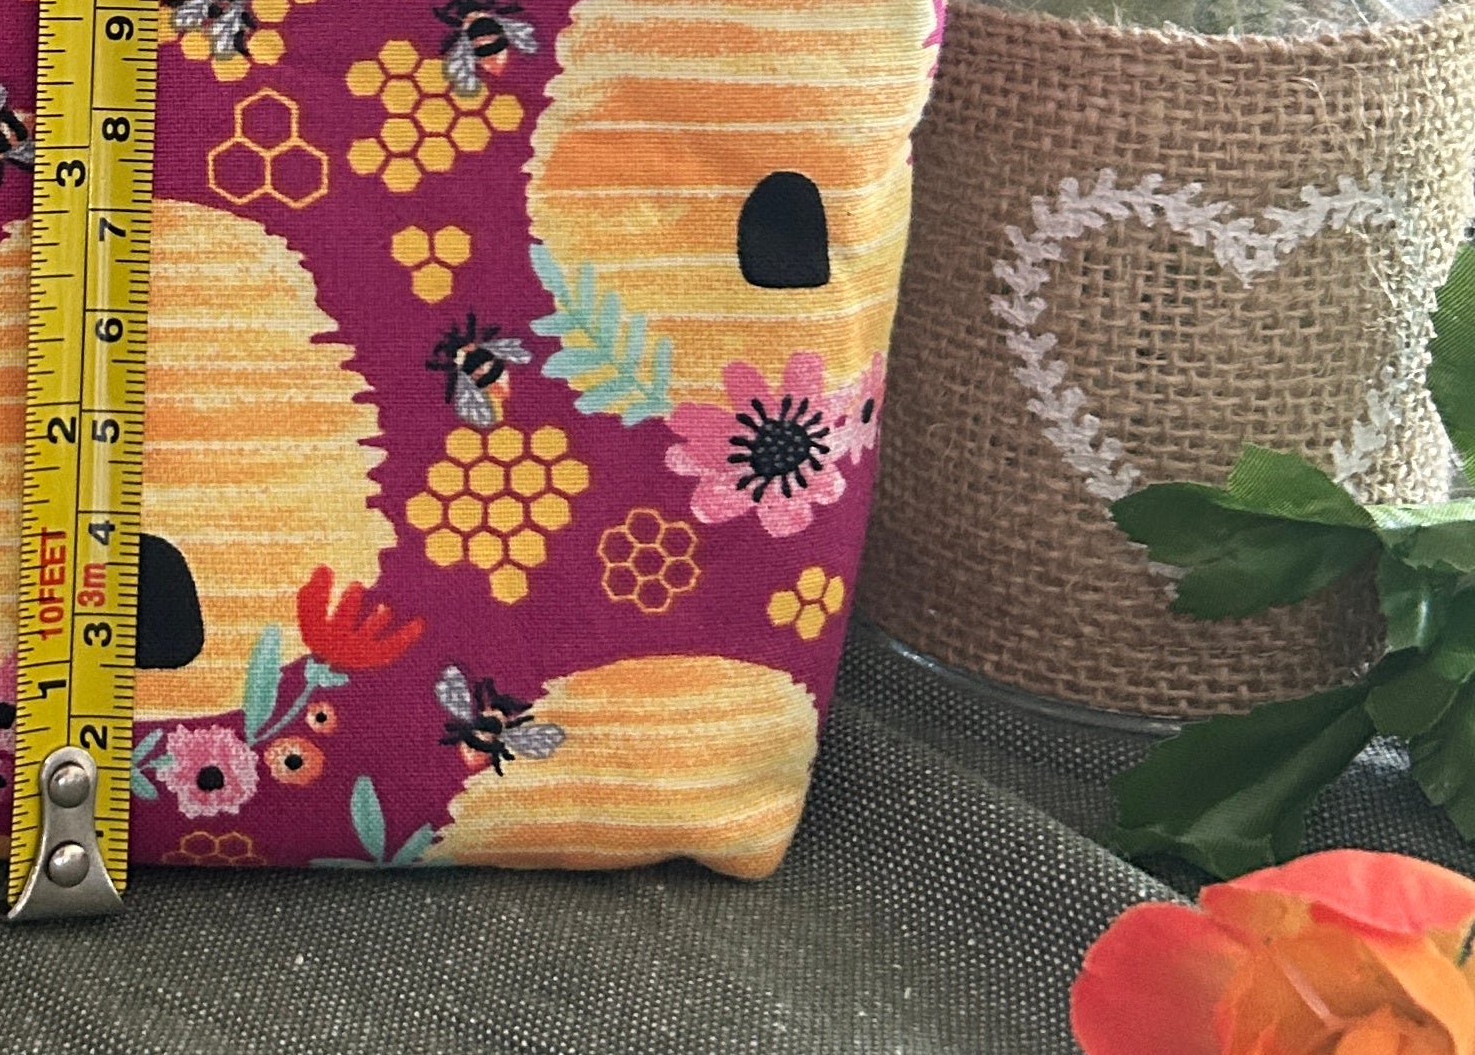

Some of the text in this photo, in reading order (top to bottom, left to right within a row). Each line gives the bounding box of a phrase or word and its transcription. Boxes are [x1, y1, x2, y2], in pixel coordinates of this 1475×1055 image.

[105, 16, 134, 40] 9
[101, 117, 130, 141] 8
[56, 159, 86, 188] 3
[99, 218, 126, 241] 7
[95, 317, 123, 342] 6
[48, 416, 77, 444] 2
[92, 419, 119, 443] 5
[88, 520, 115, 545] 4
[78, 563, 106, 607] 3m
[84, 622, 112, 647] 3
[38, 679, 67, 699] 1
[81, 725, 108, 749] 2
